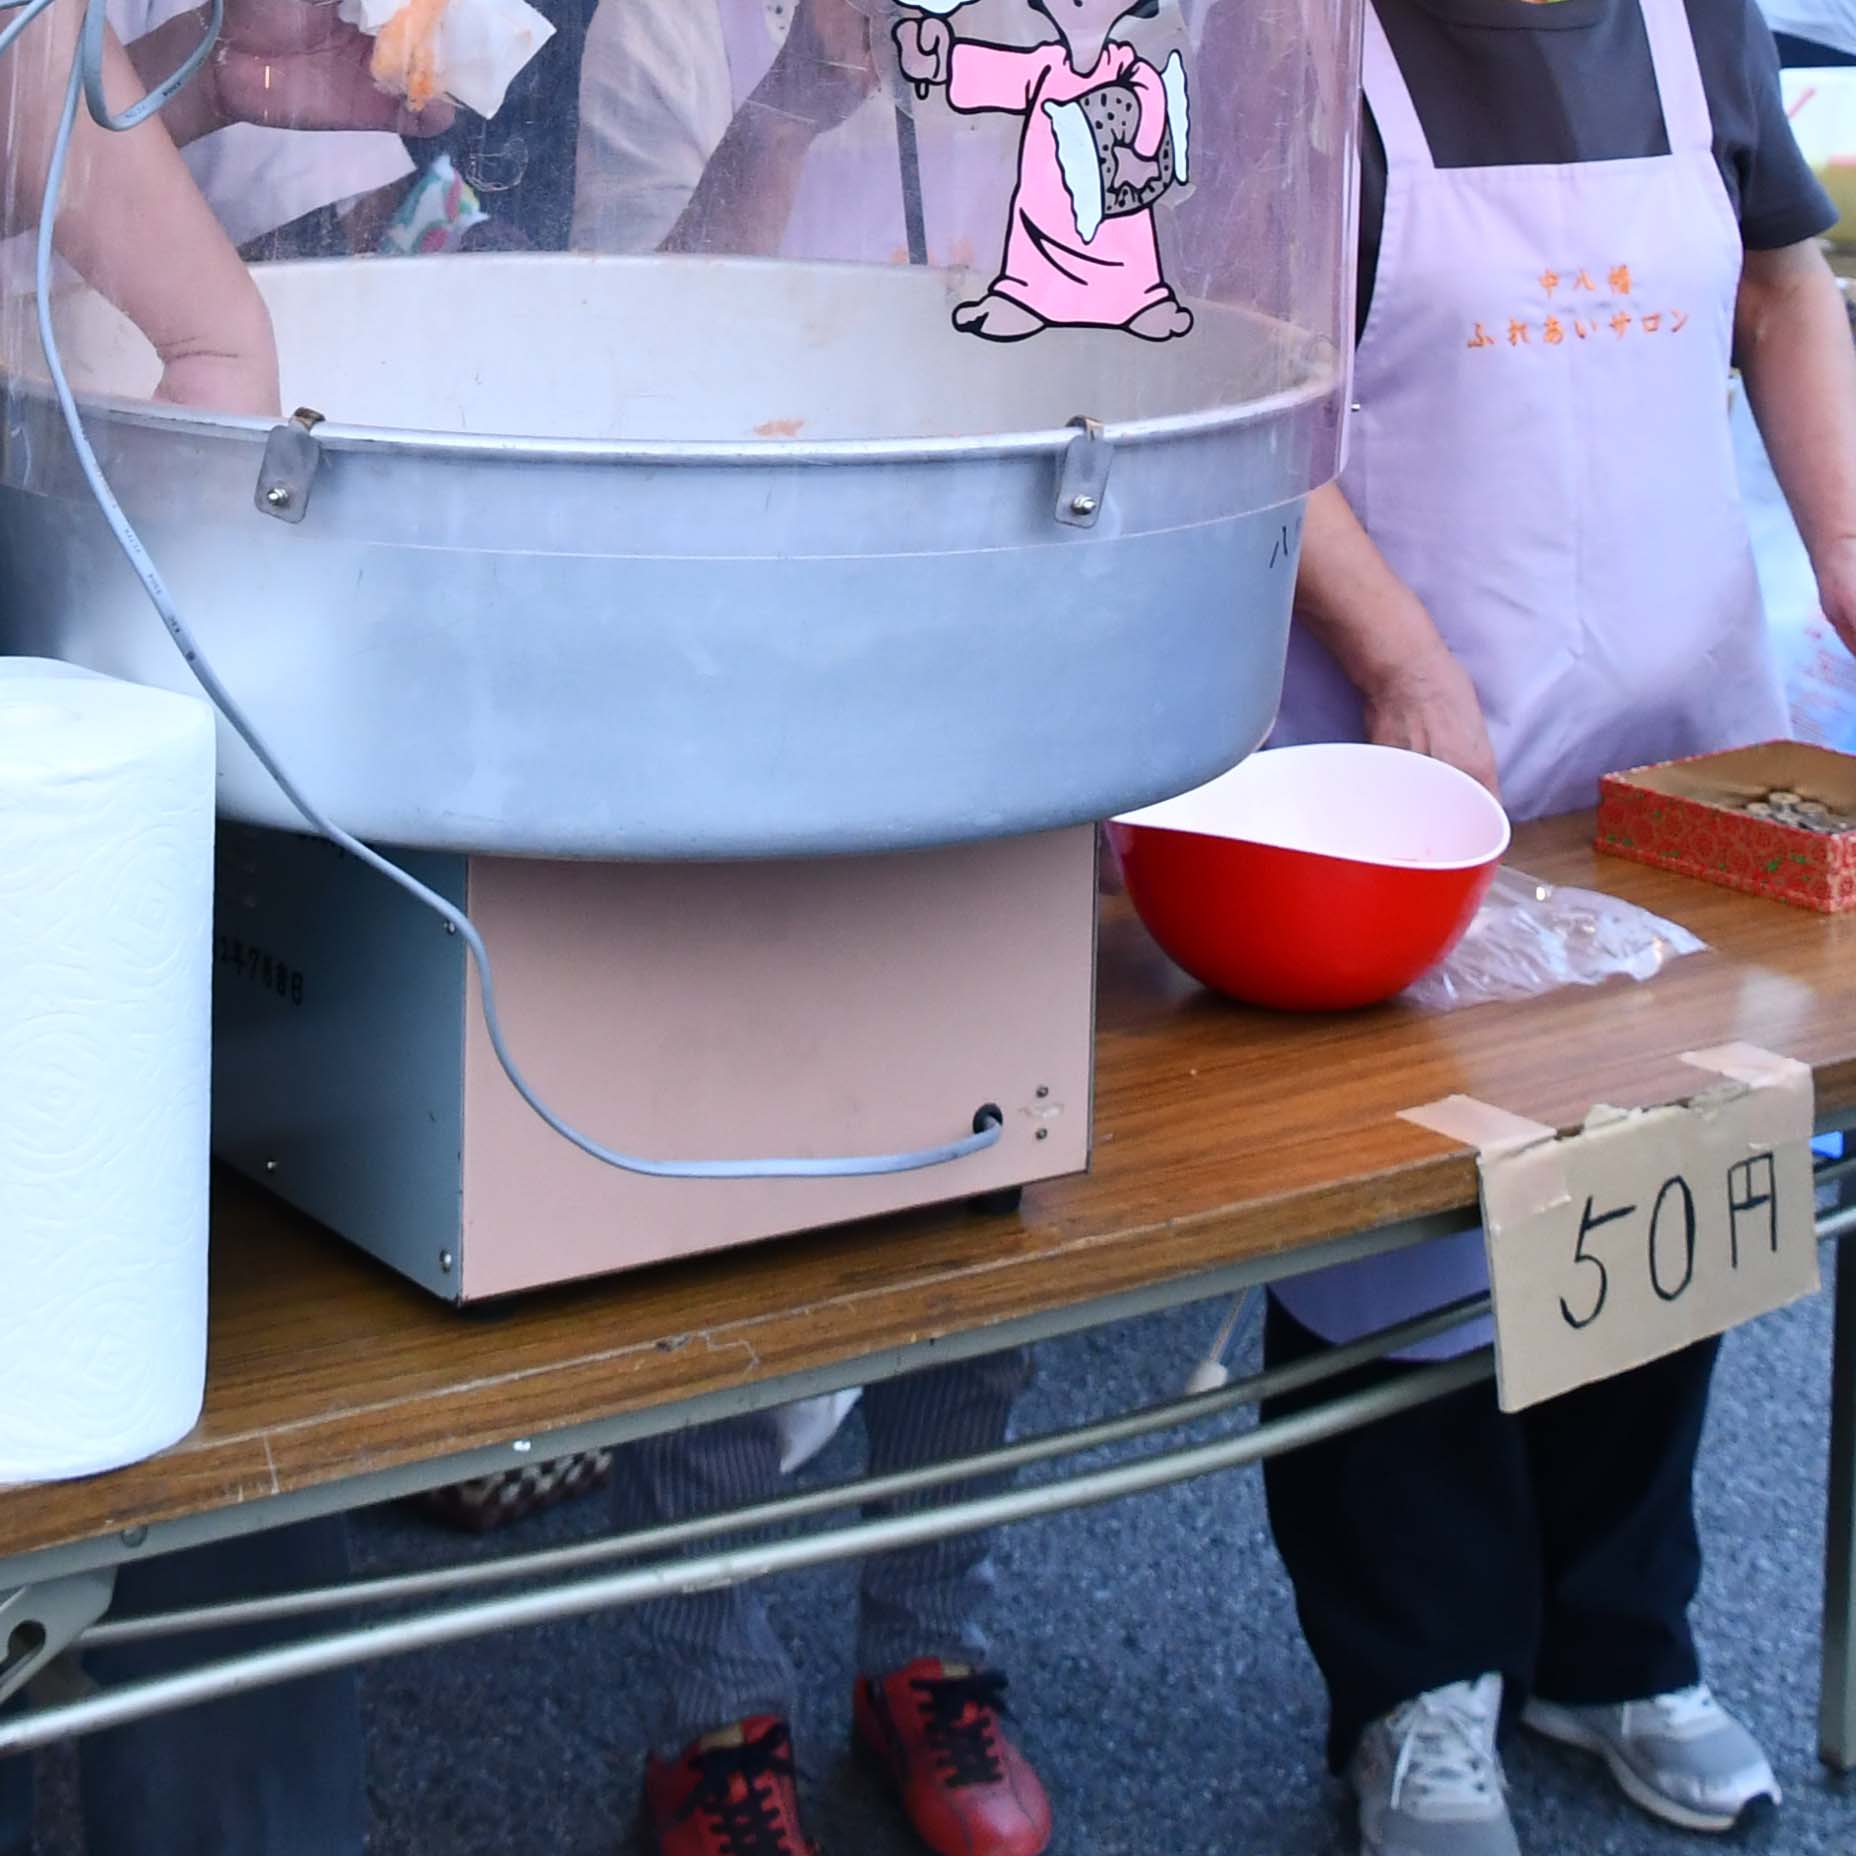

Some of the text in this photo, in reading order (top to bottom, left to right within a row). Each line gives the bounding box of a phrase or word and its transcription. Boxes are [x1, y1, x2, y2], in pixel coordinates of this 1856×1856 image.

[1467, 307, 1689, 349] ふれあいサロン
[1559, 1150, 1778, 1329] 50円
